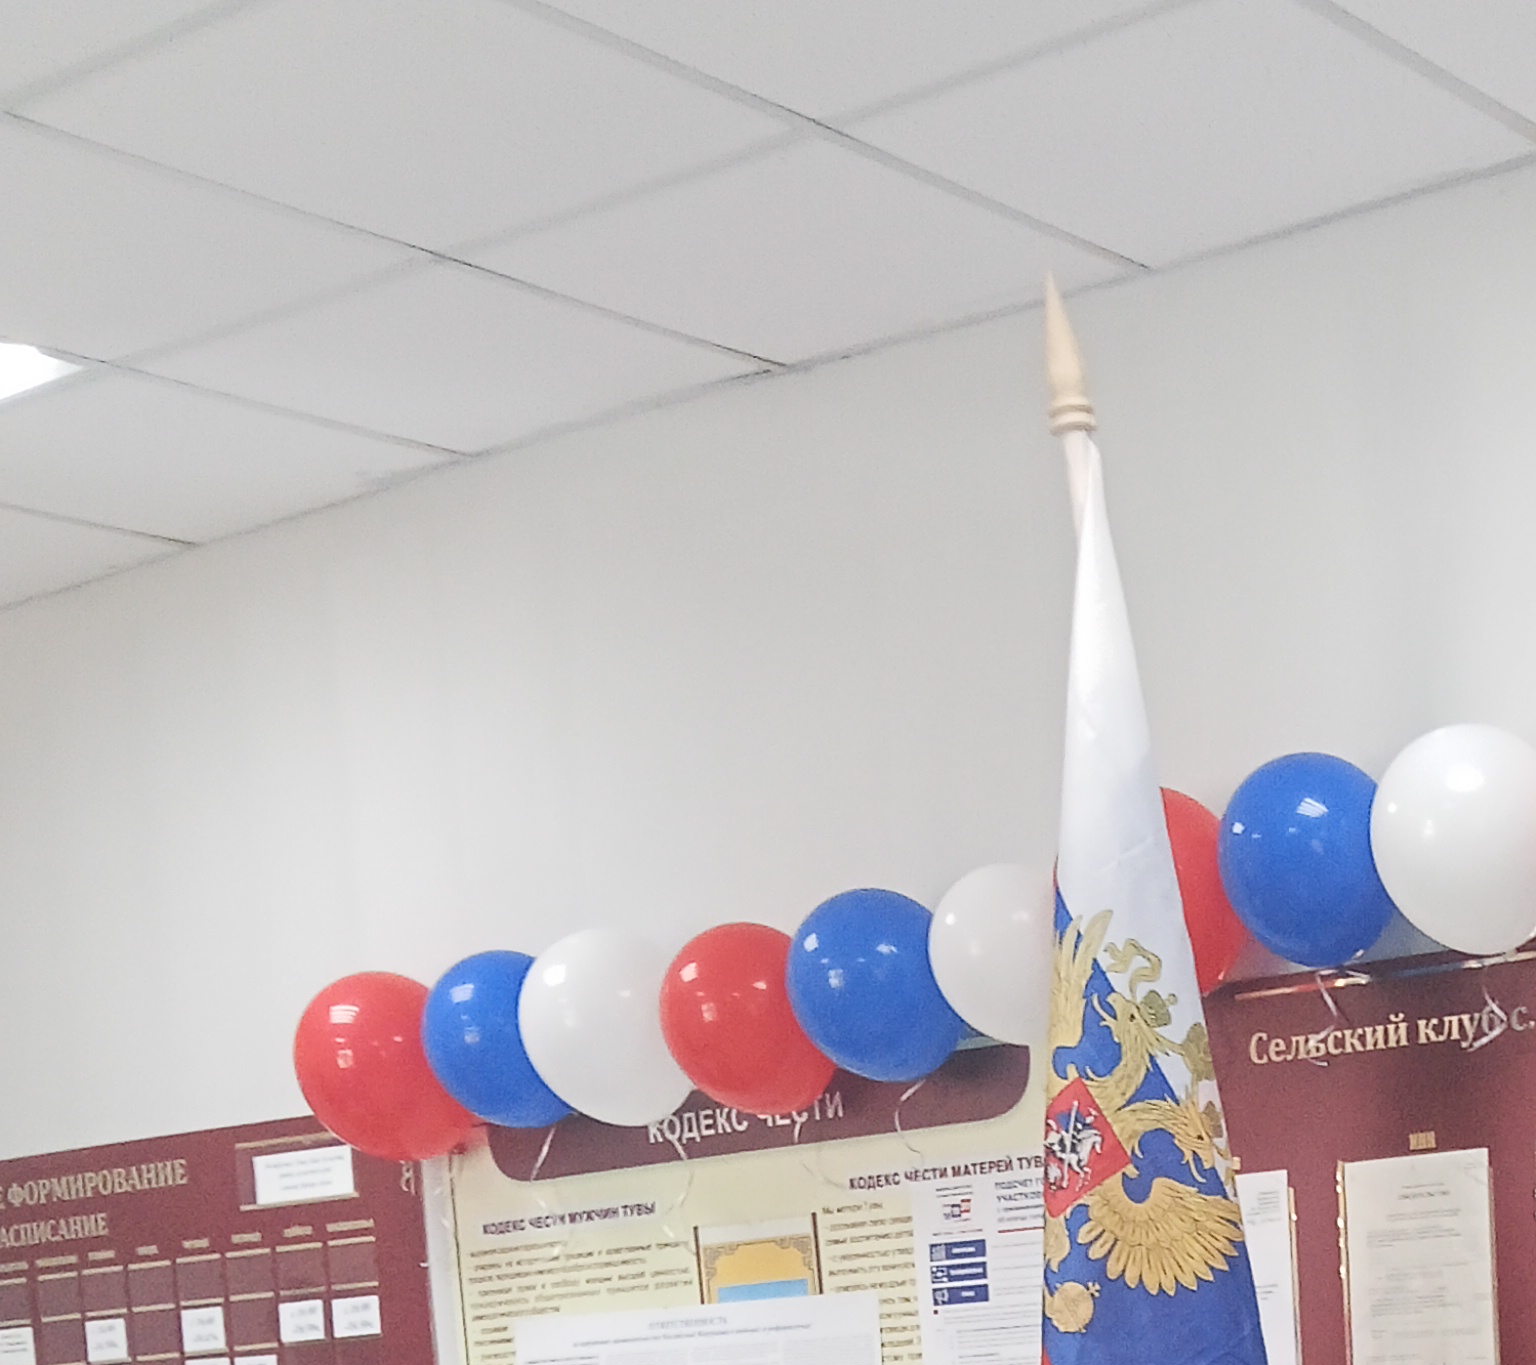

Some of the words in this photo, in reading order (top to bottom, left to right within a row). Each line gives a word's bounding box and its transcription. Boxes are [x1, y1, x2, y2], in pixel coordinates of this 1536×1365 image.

[1248, 1013, 1410, 1065] Сельский
[648, 1107, 749, 1144] КОДЕКС
[7, 1158, 191, 1207] ФОРМИРОВАНИЕ
[849, 1171, 901, 1191] КОДЕКС
[951, 1155, 1014, 1178] МАТЕРЕЙ
[1016, 1155, 1045, 1169] ТУВ
[0, 1211, 110, 1248] АСПИСАНИЕ
